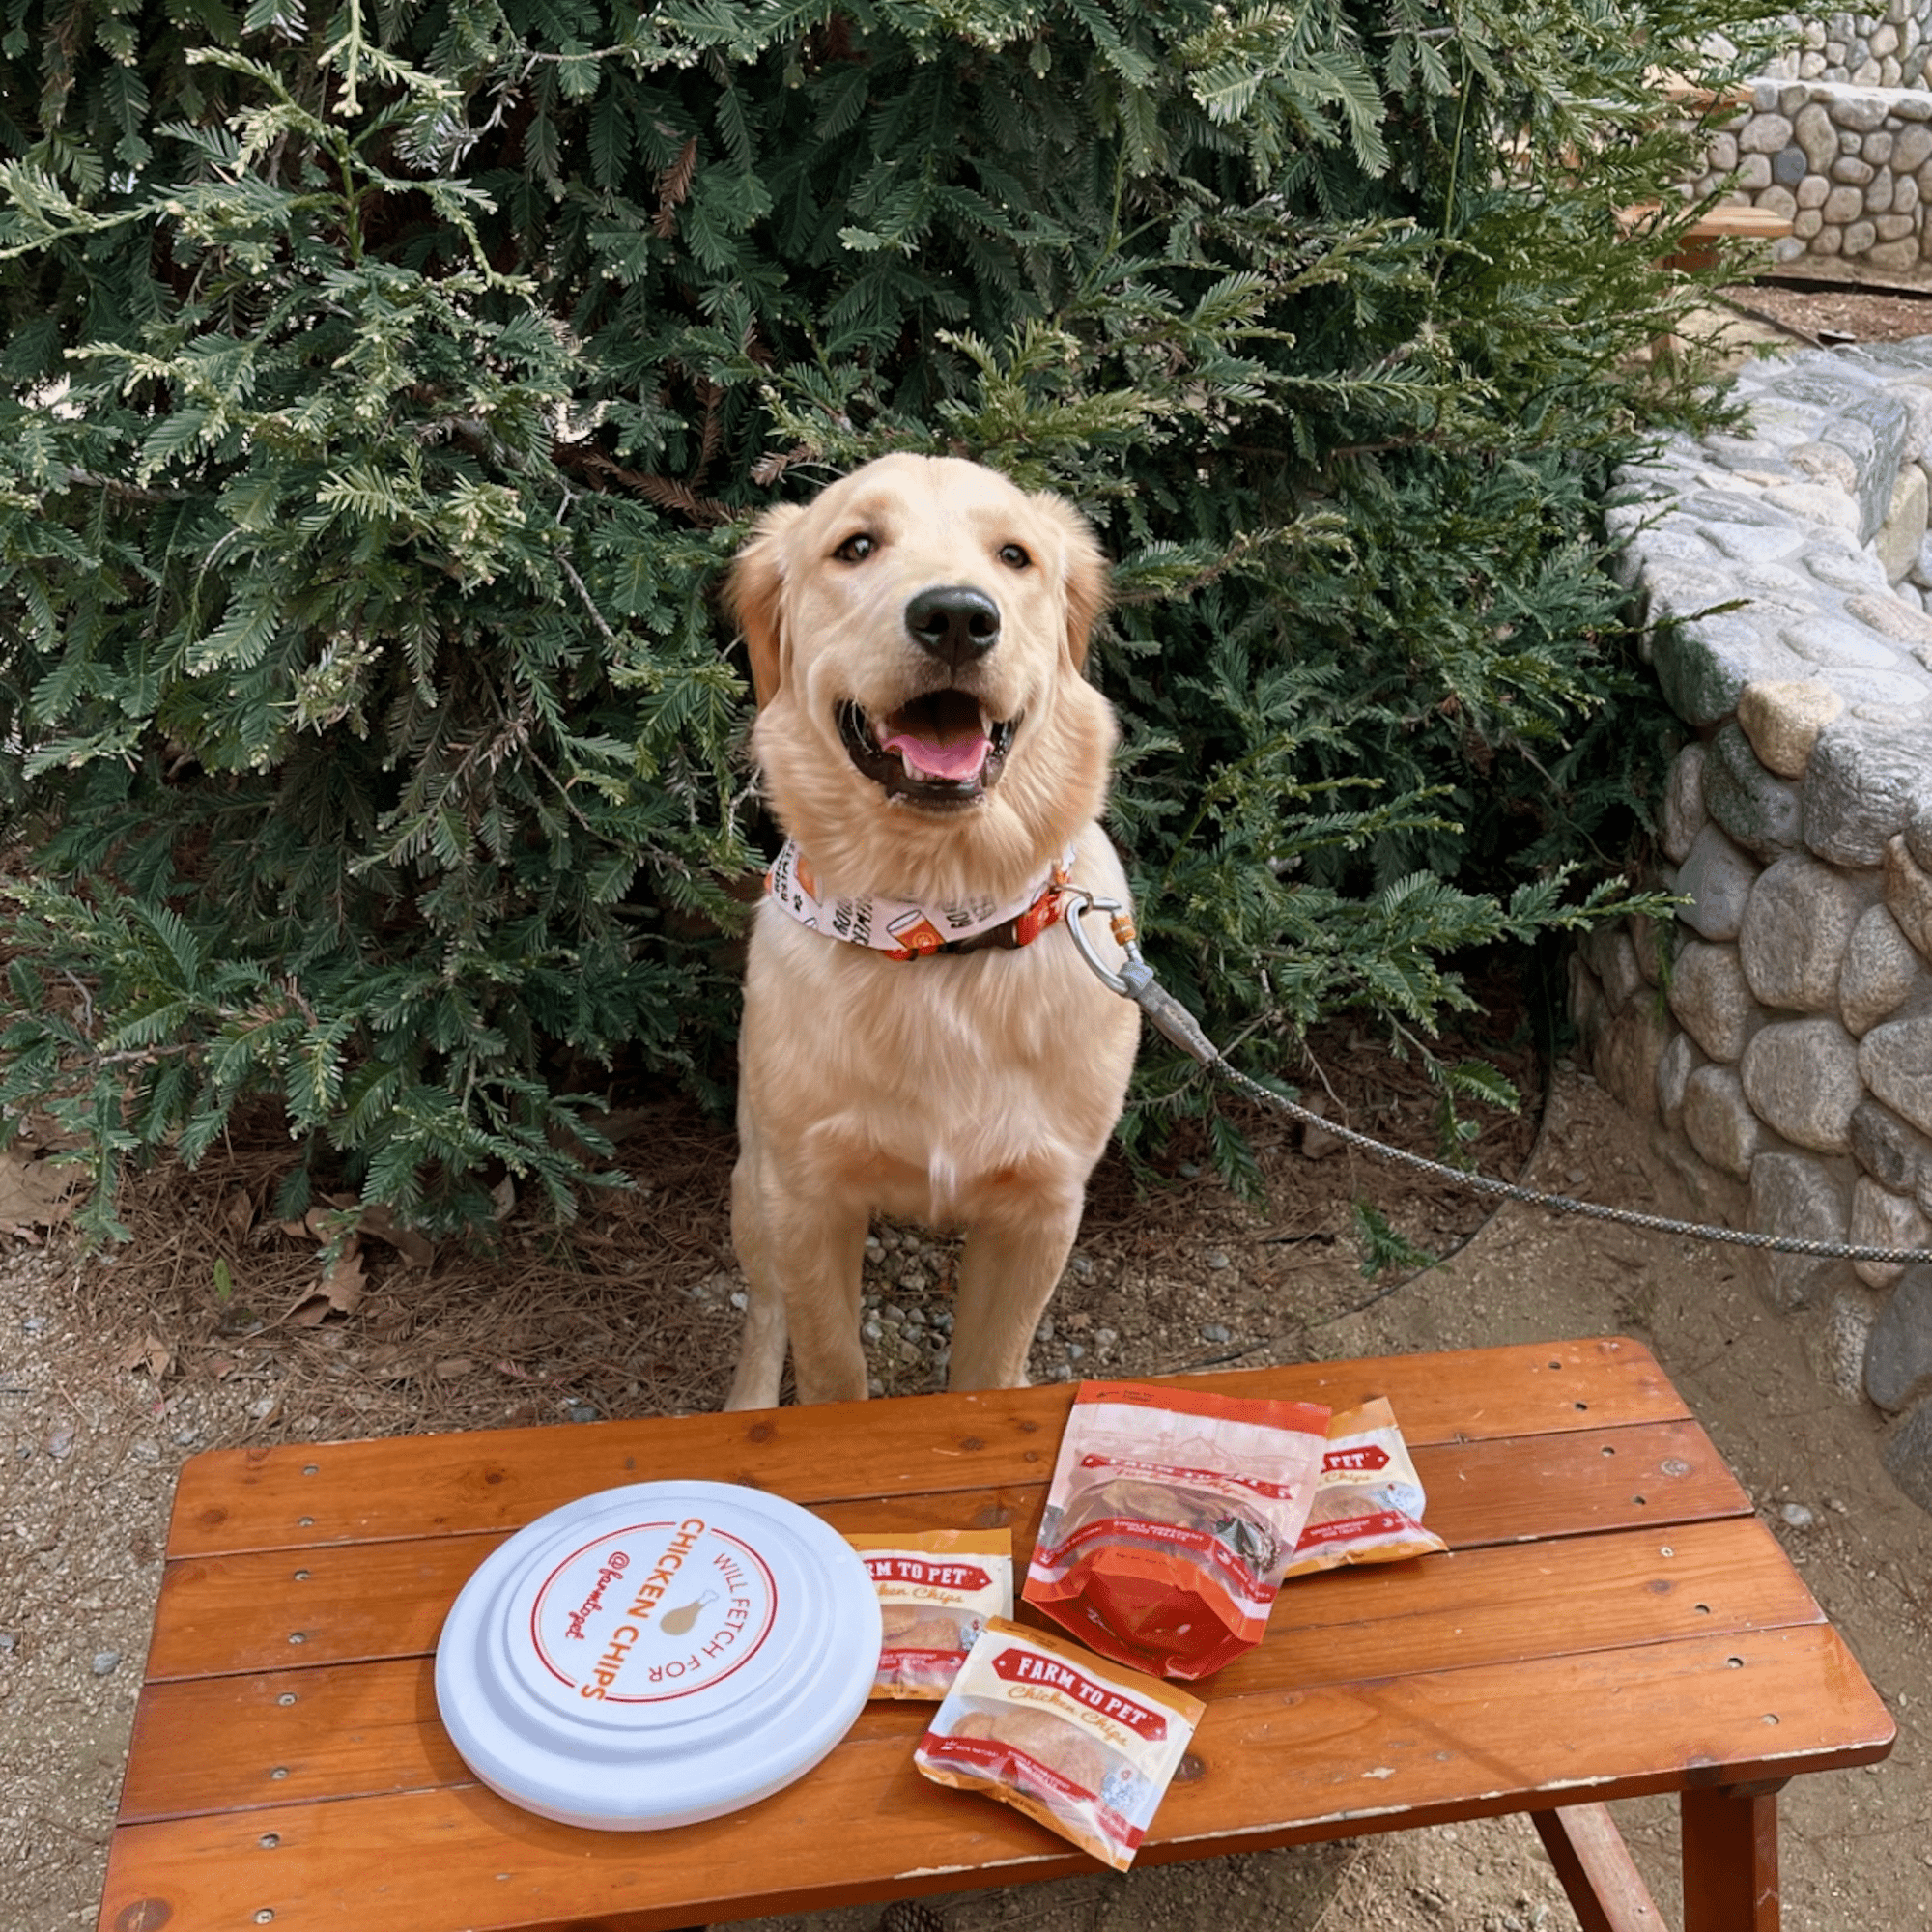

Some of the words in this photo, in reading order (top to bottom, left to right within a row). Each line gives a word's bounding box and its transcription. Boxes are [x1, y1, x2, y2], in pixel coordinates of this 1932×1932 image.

[1329, 1452, 1365, 1468] PET
[626, 1517, 706, 1619] CHICKEN
[713, 1552, 749, 1594] WILL
[866, 1562, 893, 1577] RM
[897, 1562, 923, 1579] TO
[928, 1567, 968, 1585] PET
[565, 1550, 631, 1640] @farmtopet
[701, 1597, 751, 1659] FETCH
[580, 1625, 640, 1700] CHIPS
[648, 1653, 702, 1683] FOR
[1007, 1685, 1076, 1714] Chicken
[1016, 1656, 1077, 1690] FARM
[1077, 1681, 1105, 1706] TO
[1104, 1696, 1149, 1725] PET
